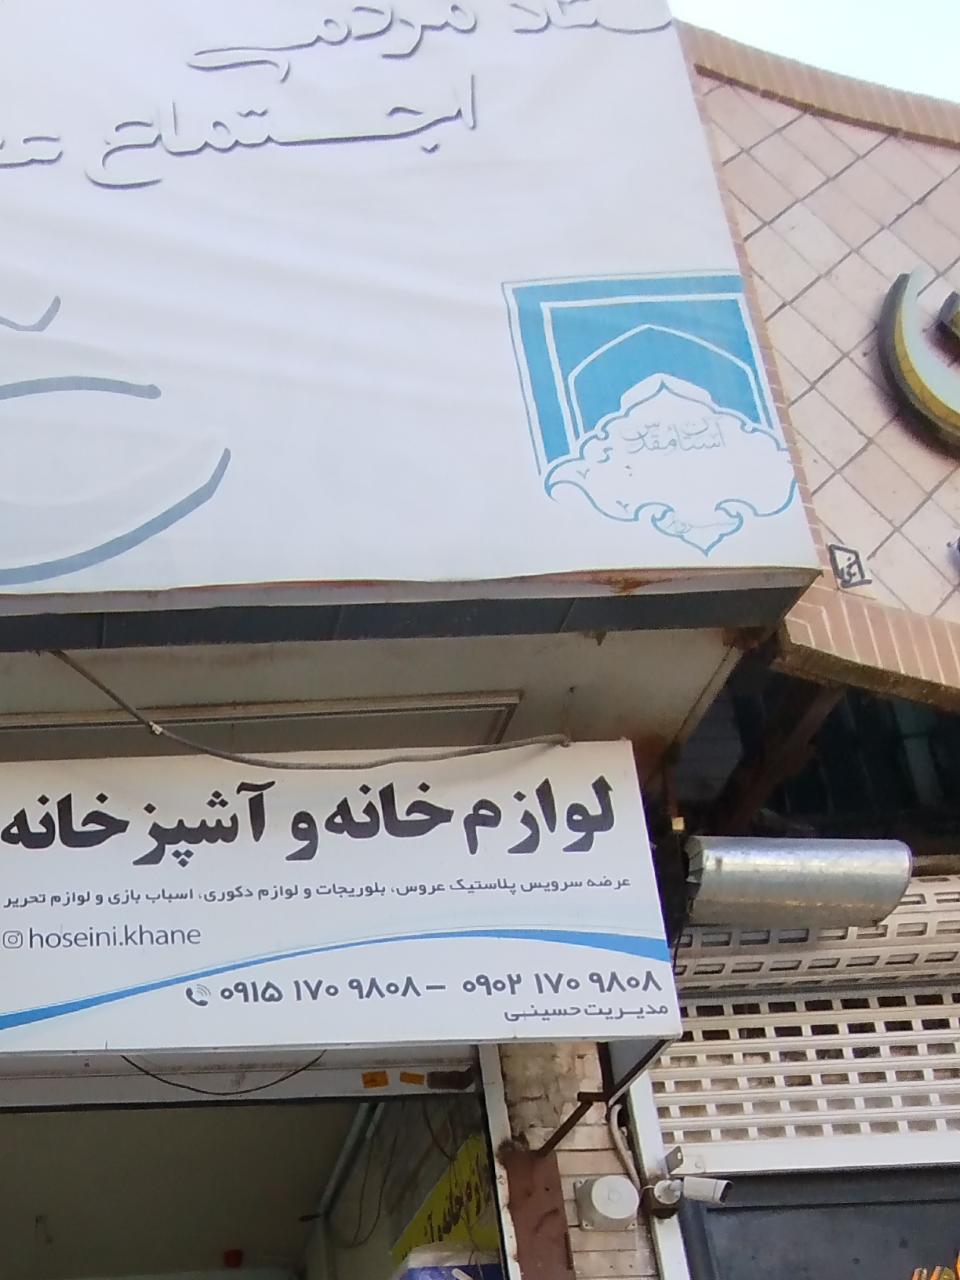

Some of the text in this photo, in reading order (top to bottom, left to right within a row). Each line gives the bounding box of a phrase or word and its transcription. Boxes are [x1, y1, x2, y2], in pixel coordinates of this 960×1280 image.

[324, 781, 454, 839] خانه
[463, 775, 614, 855] لوازم
[285, 810, 318, 861] و
[258, 883, 298, 899] لوازم
[316, 882, 385, 897] بلوریجات
[449, 877, 517, 896] پلاستیک
[520, 877, 583, 893] سرویس
[586, 875, 631, 891] عرضه
[4, 892, 46, 908] تحریر
[50, 890, 90, 906] لوازم
[95, 893, 104, 905] و
[108, 890, 141, 905] بازی
[145, 887, 193, 902] اسباب
[303, 887, 312, 899] و
[29, 924, 201, 948] hoseini.khane
[220, 981, 283, 1003] ۰۹۱۵
[294, 979, 339, 1001] ۱۷۰
[462, 974, 524, 996] ۰۹۰۲
[535, 972, 580, 994] ۱۷۰
[589, 970, 663, 993] ۹۸۰۸
[504, 1004, 668, 1022] مدیریت حسینی
